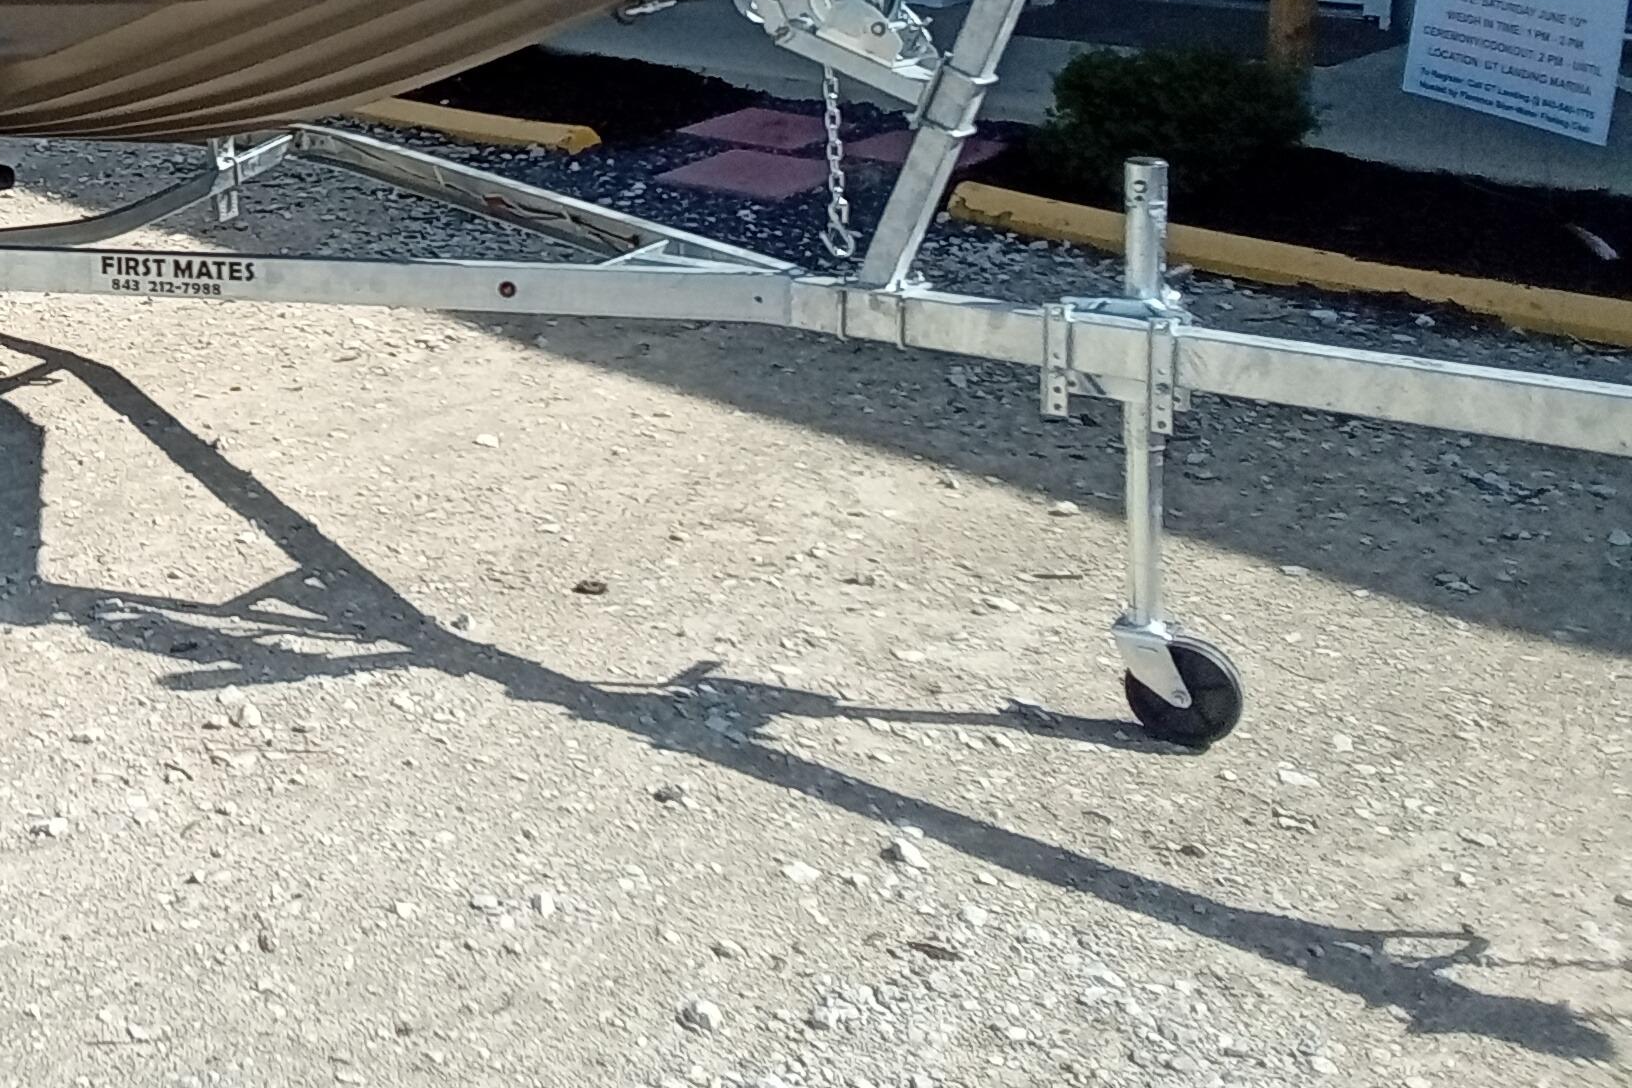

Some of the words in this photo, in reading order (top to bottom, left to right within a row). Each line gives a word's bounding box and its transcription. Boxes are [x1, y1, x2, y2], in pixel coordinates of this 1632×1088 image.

[101, 256, 166, 277] FIRST
[173, 259, 255, 281] MATES
[111, 278, 140, 291] 843
[148, 281, 221, 295] 212-7988
